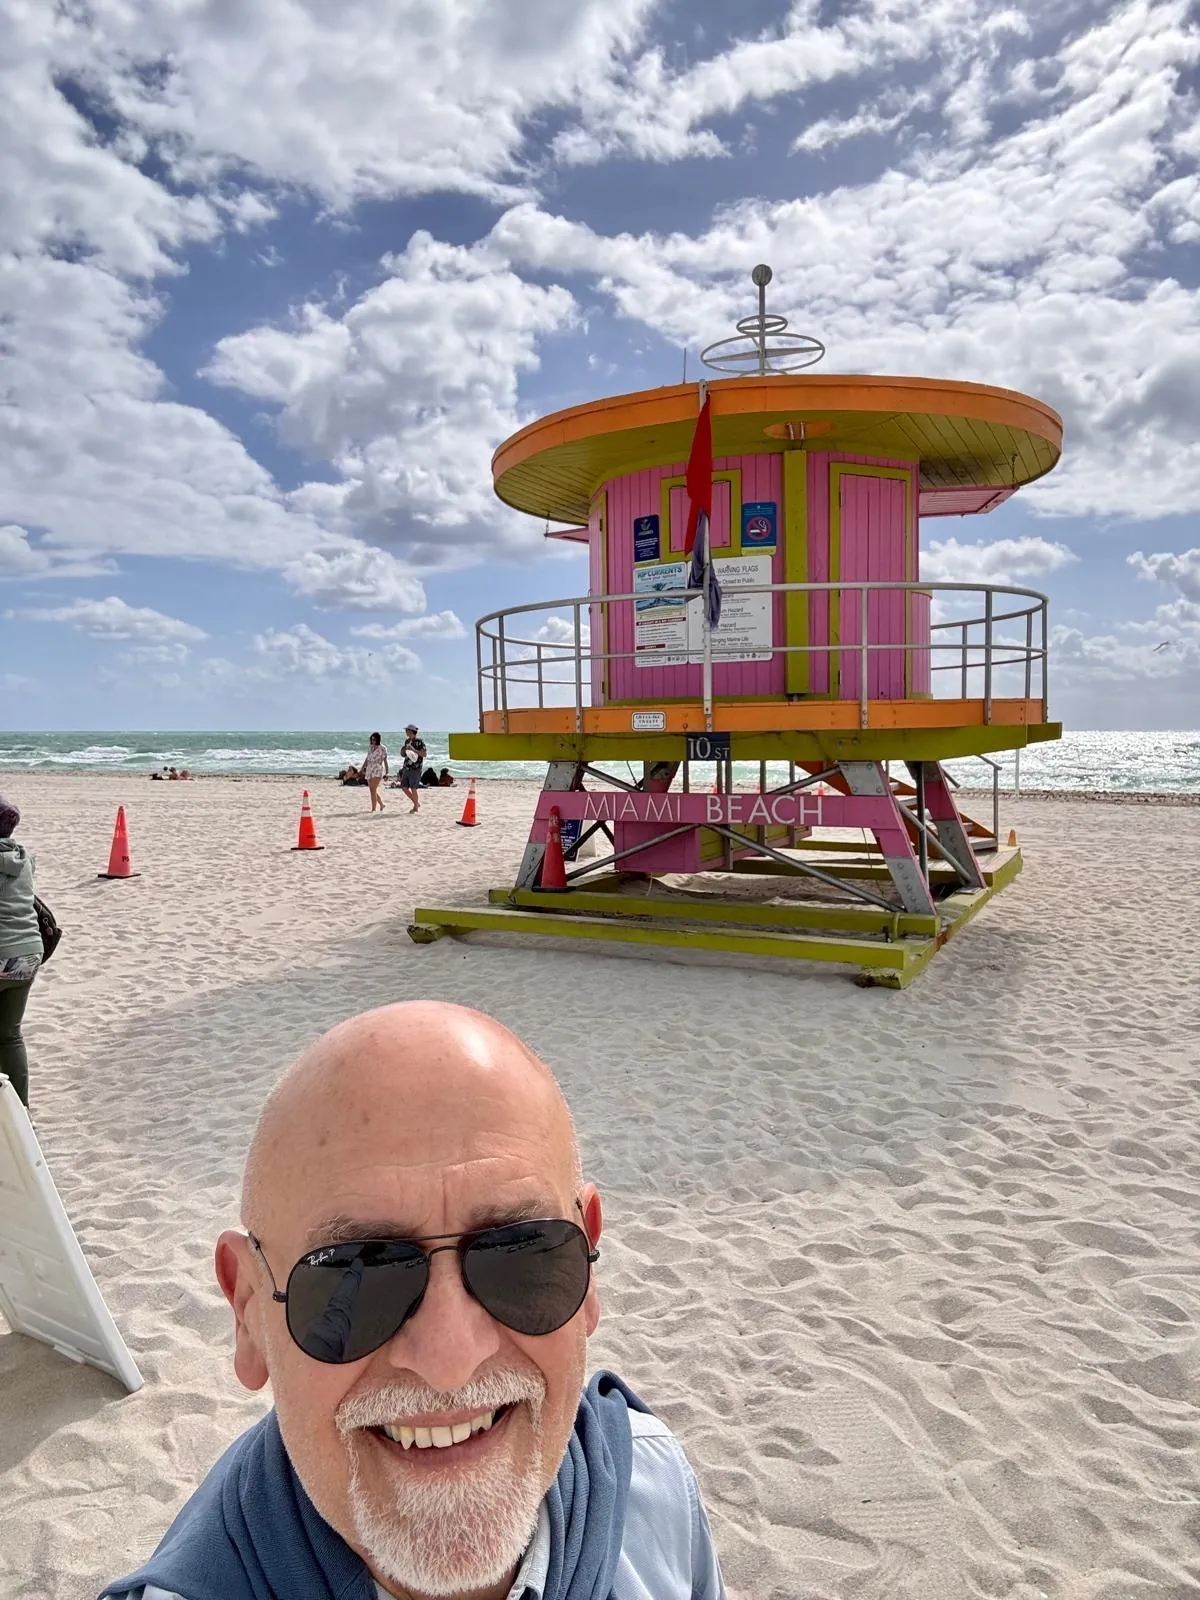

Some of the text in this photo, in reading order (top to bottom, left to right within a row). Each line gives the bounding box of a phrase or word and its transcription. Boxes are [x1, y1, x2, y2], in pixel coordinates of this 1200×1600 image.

[647, 567, 682, 577] CURRENTS
[742, 565, 759, 573] FLAGS
[688, 737, 731, 760] 10 ST
[583, 793, 823, 825] MIAMI BEACH
